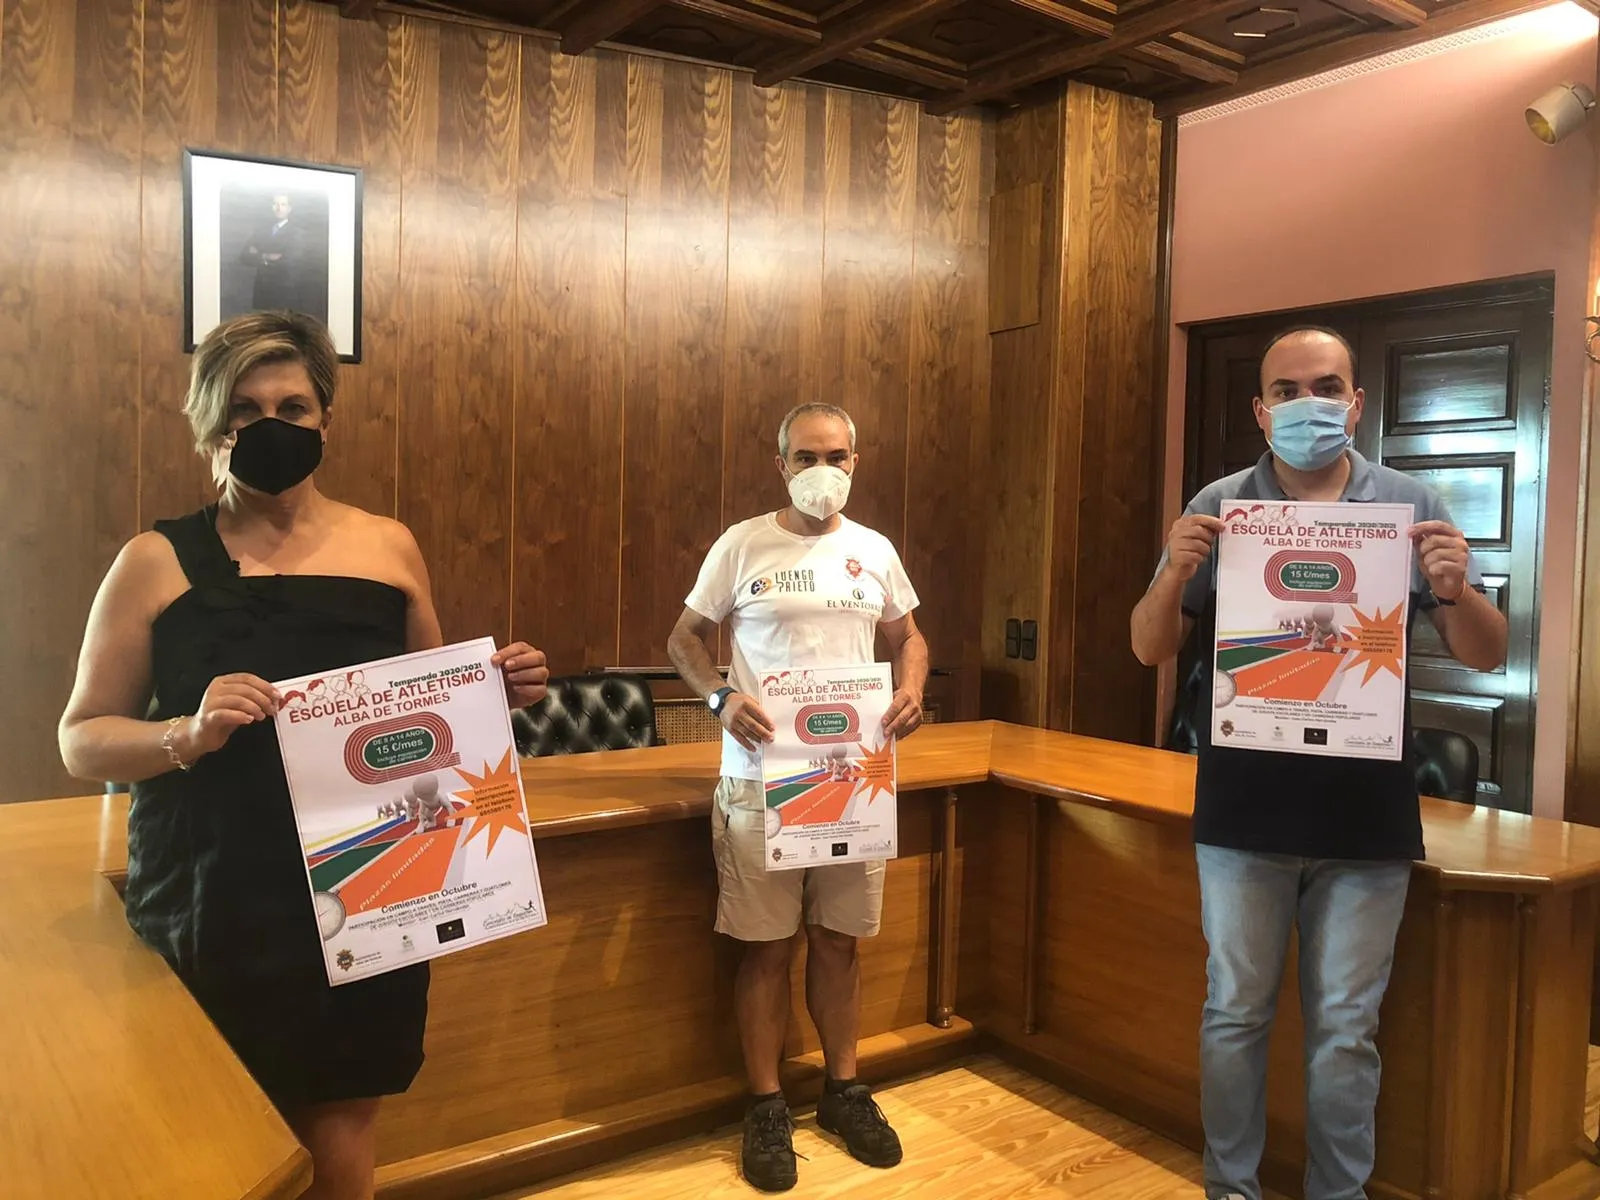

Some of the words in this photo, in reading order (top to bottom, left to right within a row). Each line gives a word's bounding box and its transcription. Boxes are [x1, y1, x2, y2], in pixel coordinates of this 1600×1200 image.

[1231, 524, 1293, 537] ESCUELA
[1297, 526, 1315, 537] DE
[1319, 527, 1398, 540] ATLETISMO
[1263, 537, 1293, 547] ALBA
[1296, 538, 1312, 548] DE
[1314, 539, 1362, 550] TORMES
[775, 569, 814, 583] LUENGO
[1291, 570, 1302, 578] 15
[779, 580, 815, 592] PRIETO
[826, 599, 837, 608] EL
[389, 671, 438, 691] Temporada
[439, 662, 483, 678] 2020/2021
[289, 696, 368, 724] ESCUELA
[371, 689, 394, 705] DE
[398, 669, 487, 700] ATLETISMO
[767, 686, 814, 697] ESCUELA
[815, 684, 829, 694] DE
[830, 682, 883, 693] ATLETISMO
[792, 695, 814, 704] ALBA
[815, 694, 828, 703] DE
[829, 692, 862, 702] TORMES
[1263, 697, 1302, 707] Comienzo
[1315, 701, 1348, 709] Octubre
[333, 707, 370, 728] ALBA
[373, 703, 393, 719] DE
[394, 692, 451, 714] TORMES
[372, 738, 383, 746] DE
[376, 744, 390, 755] 15
[391, 738, 424, 752] €/mes
[381, 896, 426, 914] Comienzo
[427, 892, 440, 902] en
[441, 881, 478, 898] Octubre
